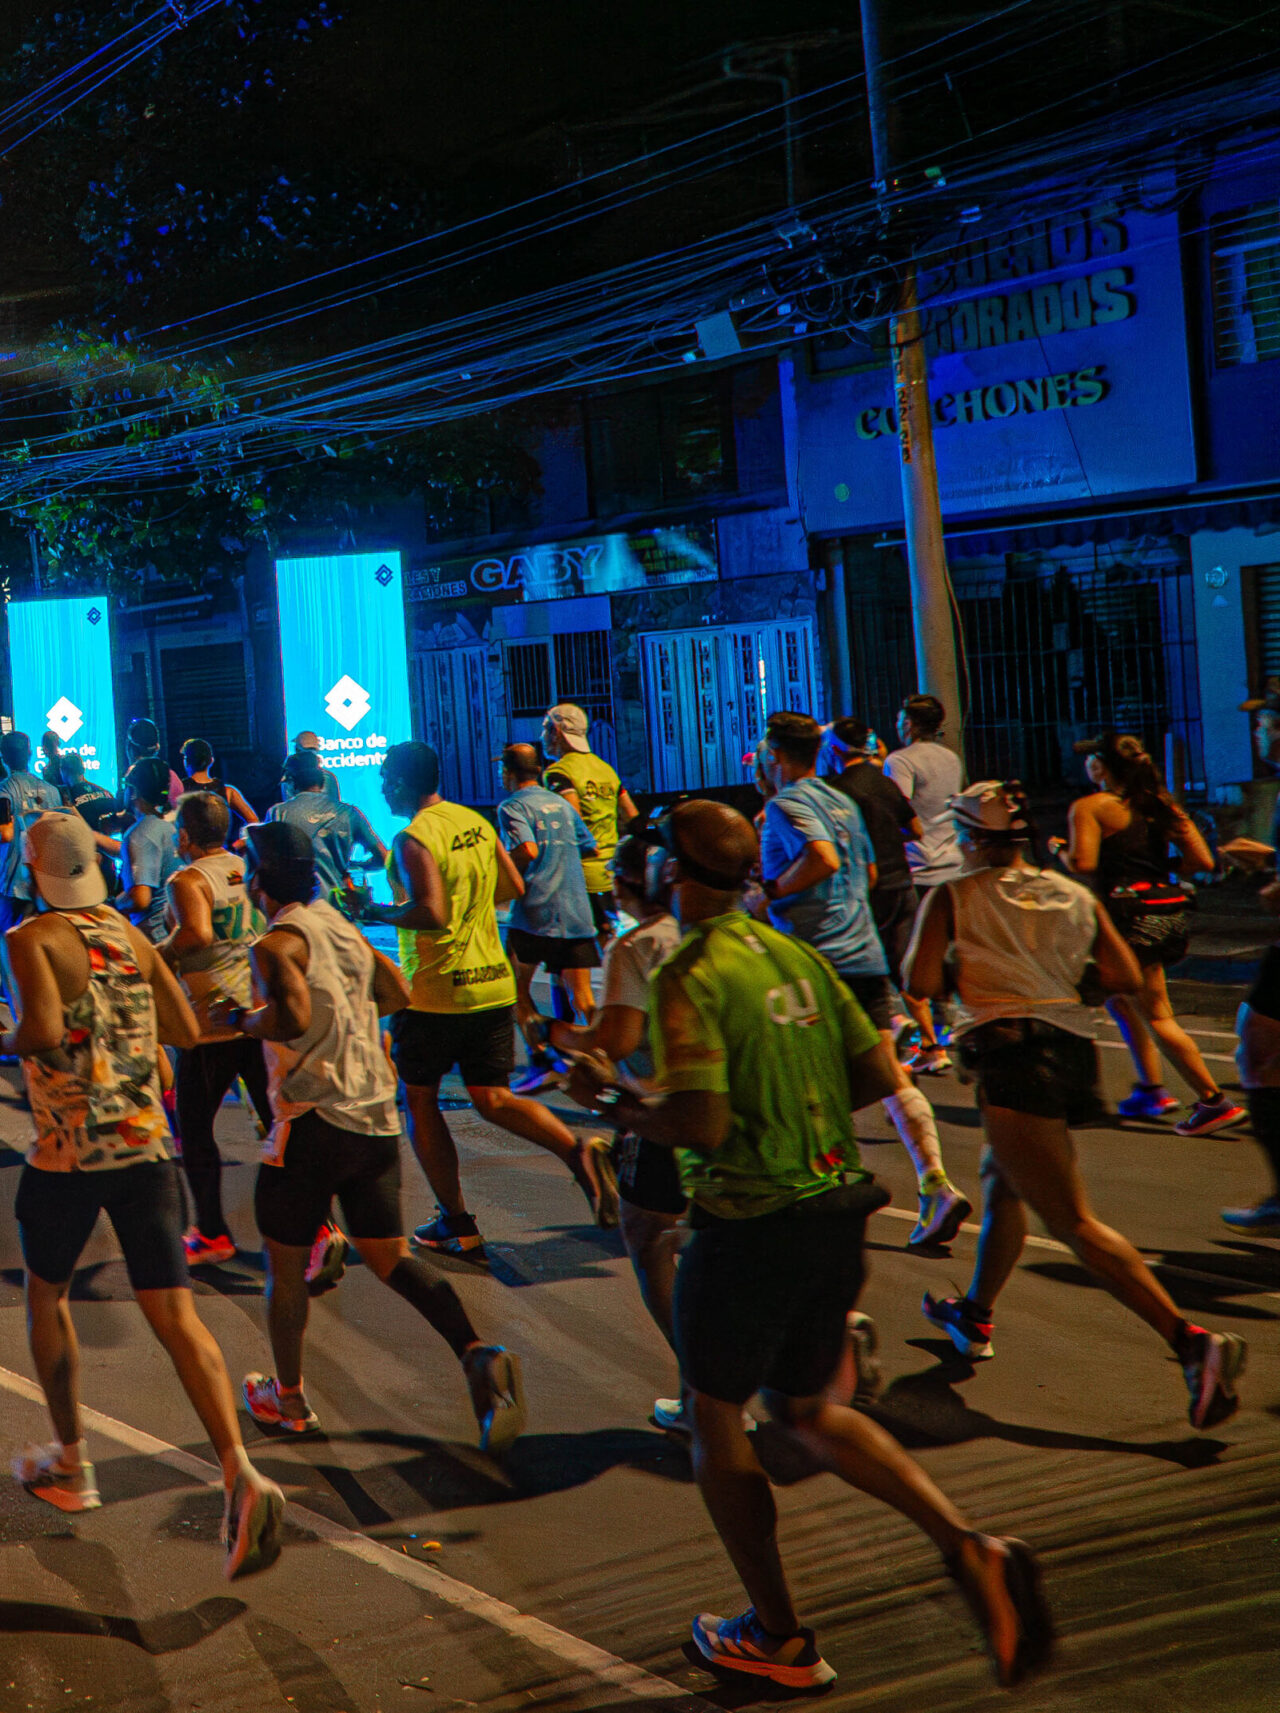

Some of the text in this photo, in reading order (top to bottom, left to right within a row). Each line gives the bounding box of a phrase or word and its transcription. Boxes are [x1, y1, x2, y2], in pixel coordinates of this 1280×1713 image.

[923, 267, 1132, 357] DORADOS
[855, 366, 1107, 440] COCHONES
[470, 545, 604, 592] GABY
[79, 744, 96, 756] de
[317, 733, 387, 751] Banco de
[451, 826, 488, 851] 42K
